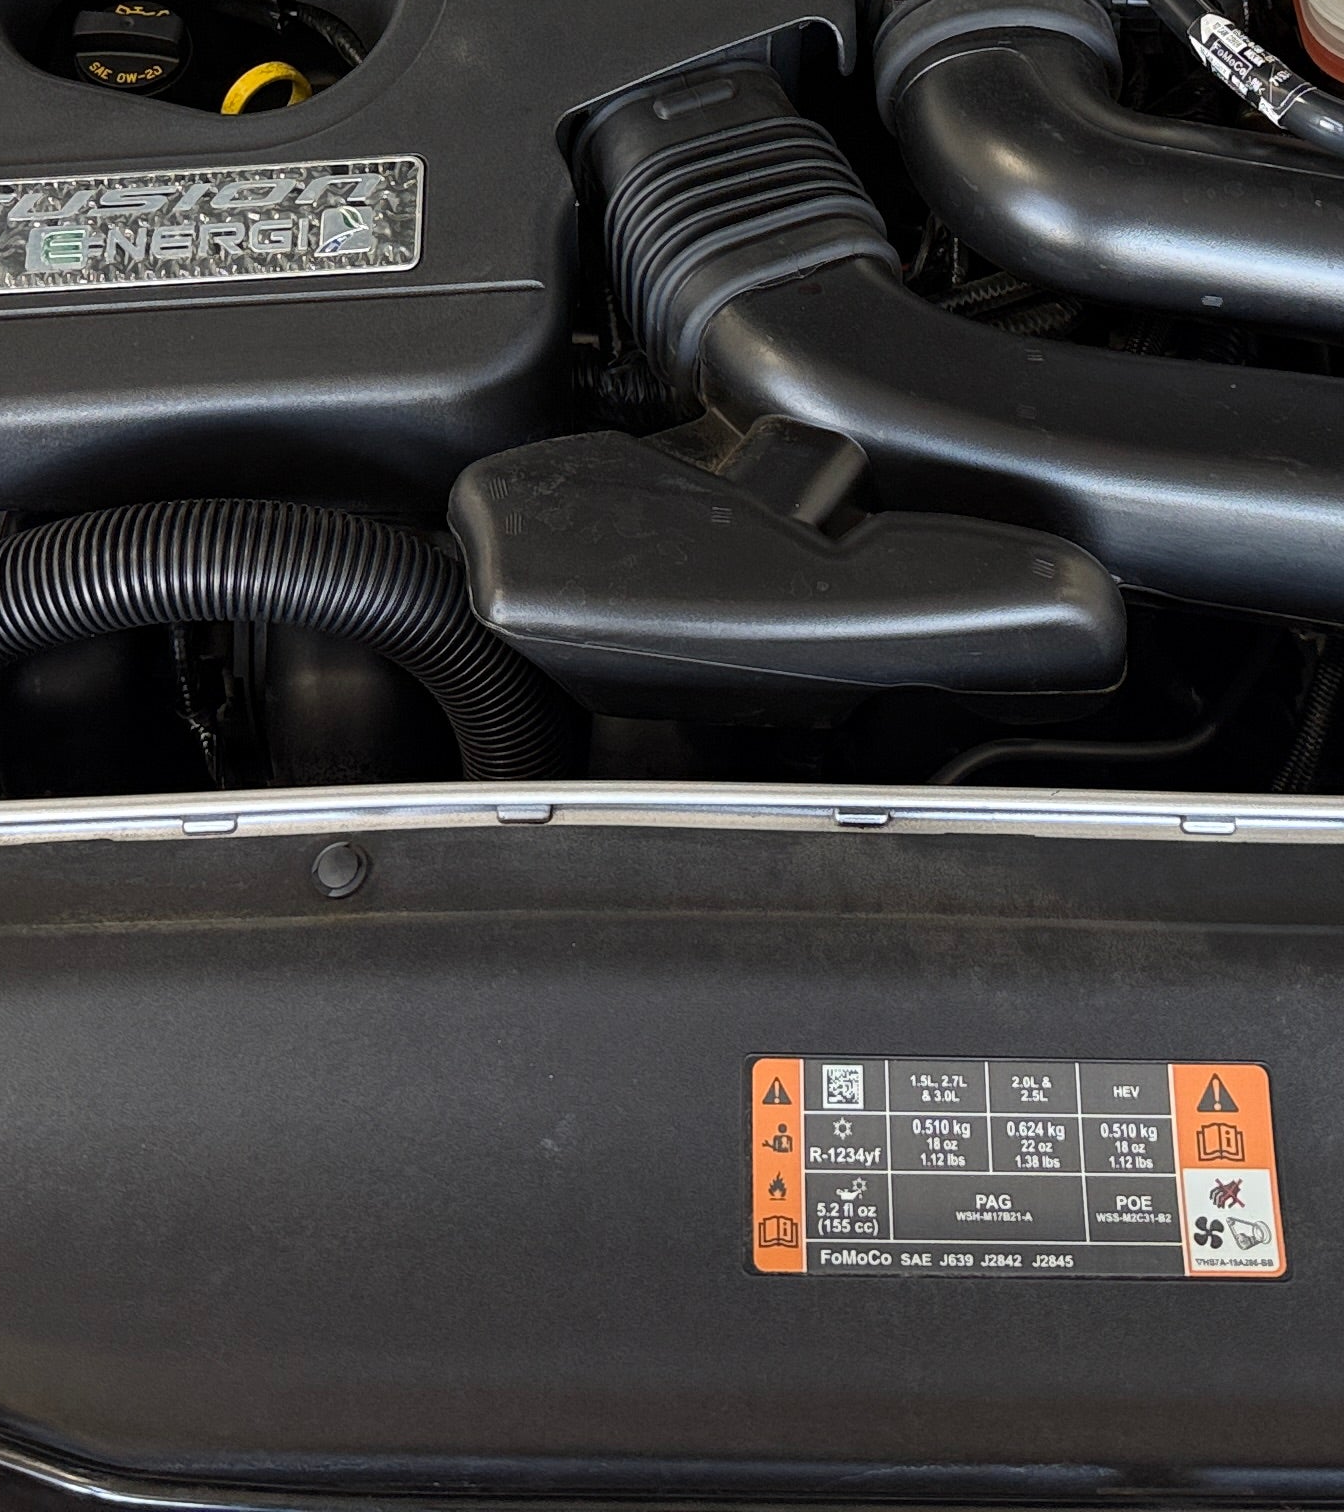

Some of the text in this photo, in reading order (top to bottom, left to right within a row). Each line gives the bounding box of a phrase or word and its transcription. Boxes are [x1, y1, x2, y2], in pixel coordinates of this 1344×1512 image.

[1213, 40, 1248, 77] FoMoCo
[88, 61, 163, 84] SAE 0W-20
[28, 216, 310, 271] ENERGI
[941, 1075, 967, 1087] 2.7L
[1011, 1076, 1051, 1088] 2.0L &
[921, 1090, 960, 1102] & 3.0L
[1020, 1090, 1048, 1102] 2.5L
[1113, 1086, 1140, 1098] HEV
[912, 1119, 971, 1138] 0.510 kg
[1006, 1121, 1065, 1141] 0.624 kg
[1100, 1123, 1158, 1142] 0.510 kg
[927, 1138, 958, 1151] 18 oz
[1021, 1140, 1053, 1153] 22 oz
[1115, 1141, 1146, 1154] 18 oz
[809, 1147, 882, 1167] R-1234yf
[920, 1153, 966, 1166] 1.12 lbs
[1015, 1156, 1061, 1169] 1.38 lbs
[1109, 1156, 1154, 1169] 1.12 lbs
[975, 1194, 1012, 1209] PAG
[1116, 1195, 1153, 1211] POE
[816, 1203, 878, 1218] 5.2 fl oz
[817, 1218, 879, 1237] (155 cc)
[820, 1250, 1074, 1268] FoMoCo SAE J639 J2842 J2845
